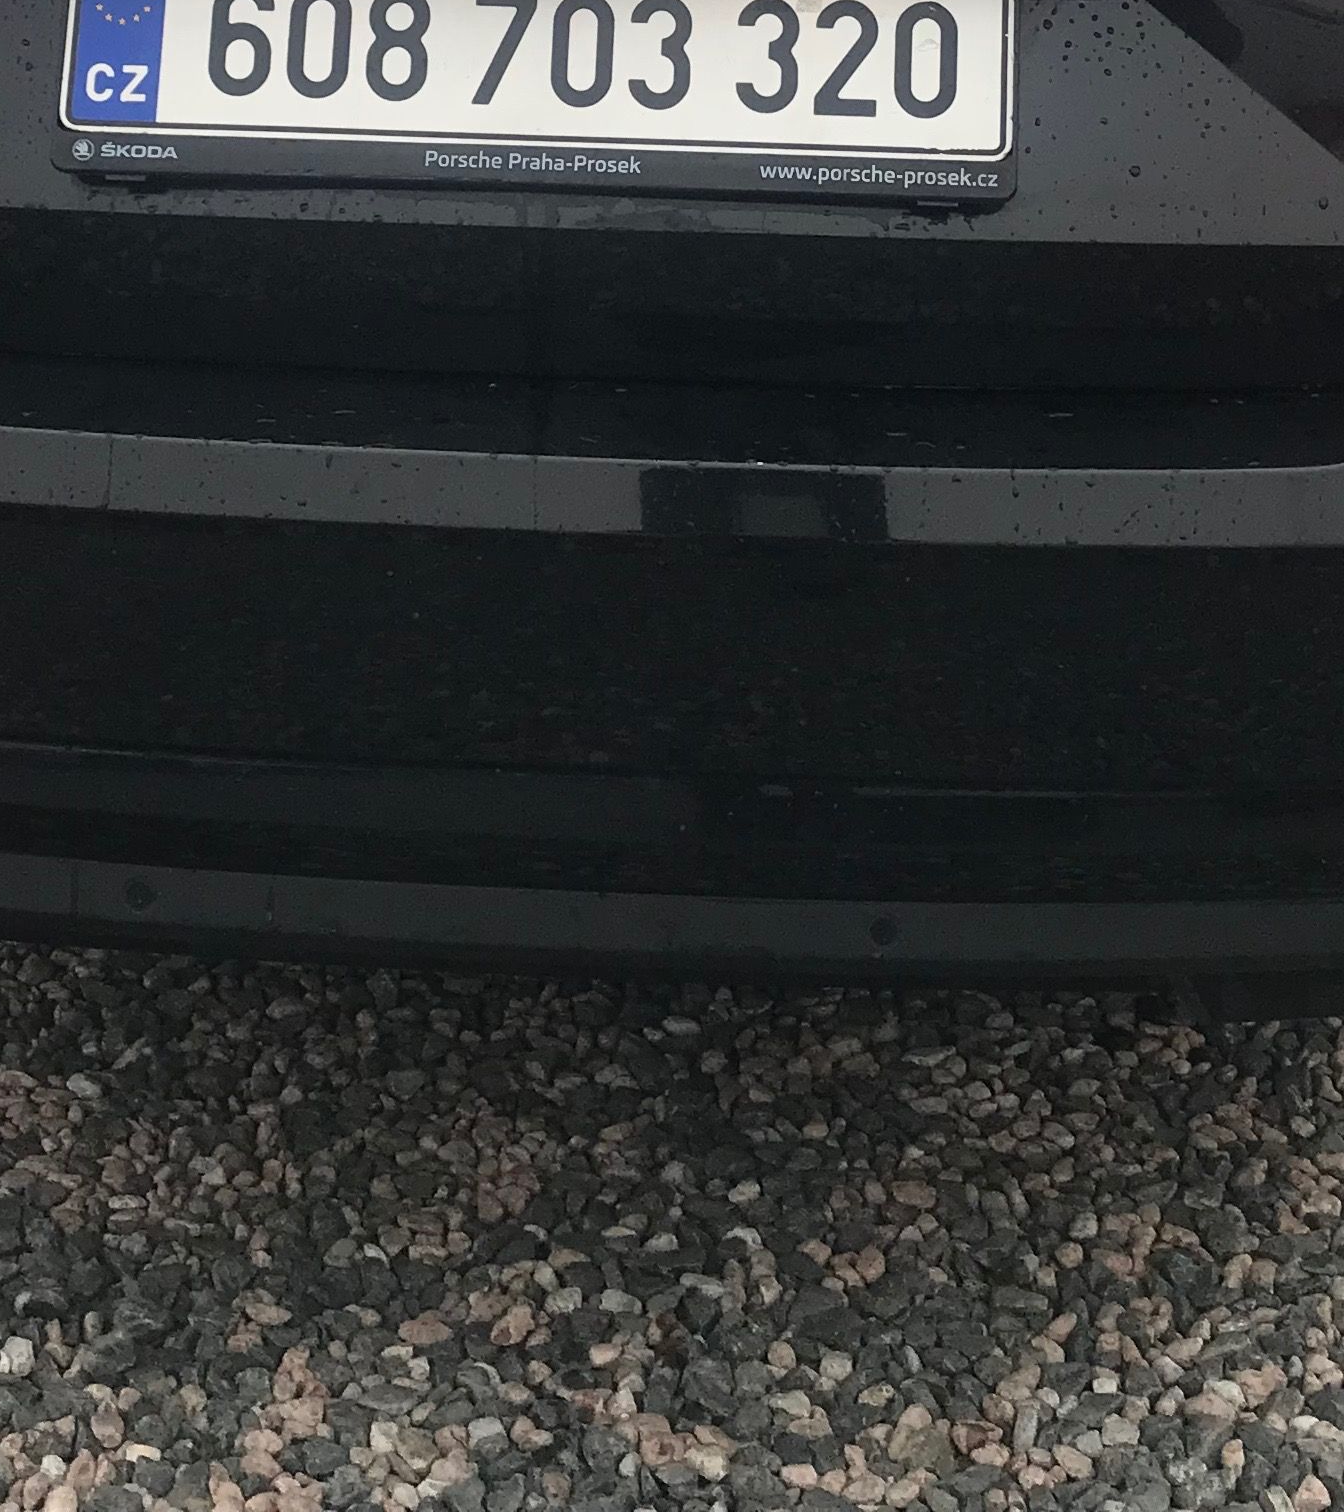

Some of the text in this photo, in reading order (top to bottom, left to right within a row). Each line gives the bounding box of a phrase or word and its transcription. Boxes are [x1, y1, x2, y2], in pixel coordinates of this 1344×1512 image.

[85, 62, 149, 103] CZ
[100, 141, 178, 159] ŠKODA
[424, 149, 642, 175] Porsche Praha-Prosek
[759, 164, 999, 188] www.porsche-prosek.cz
